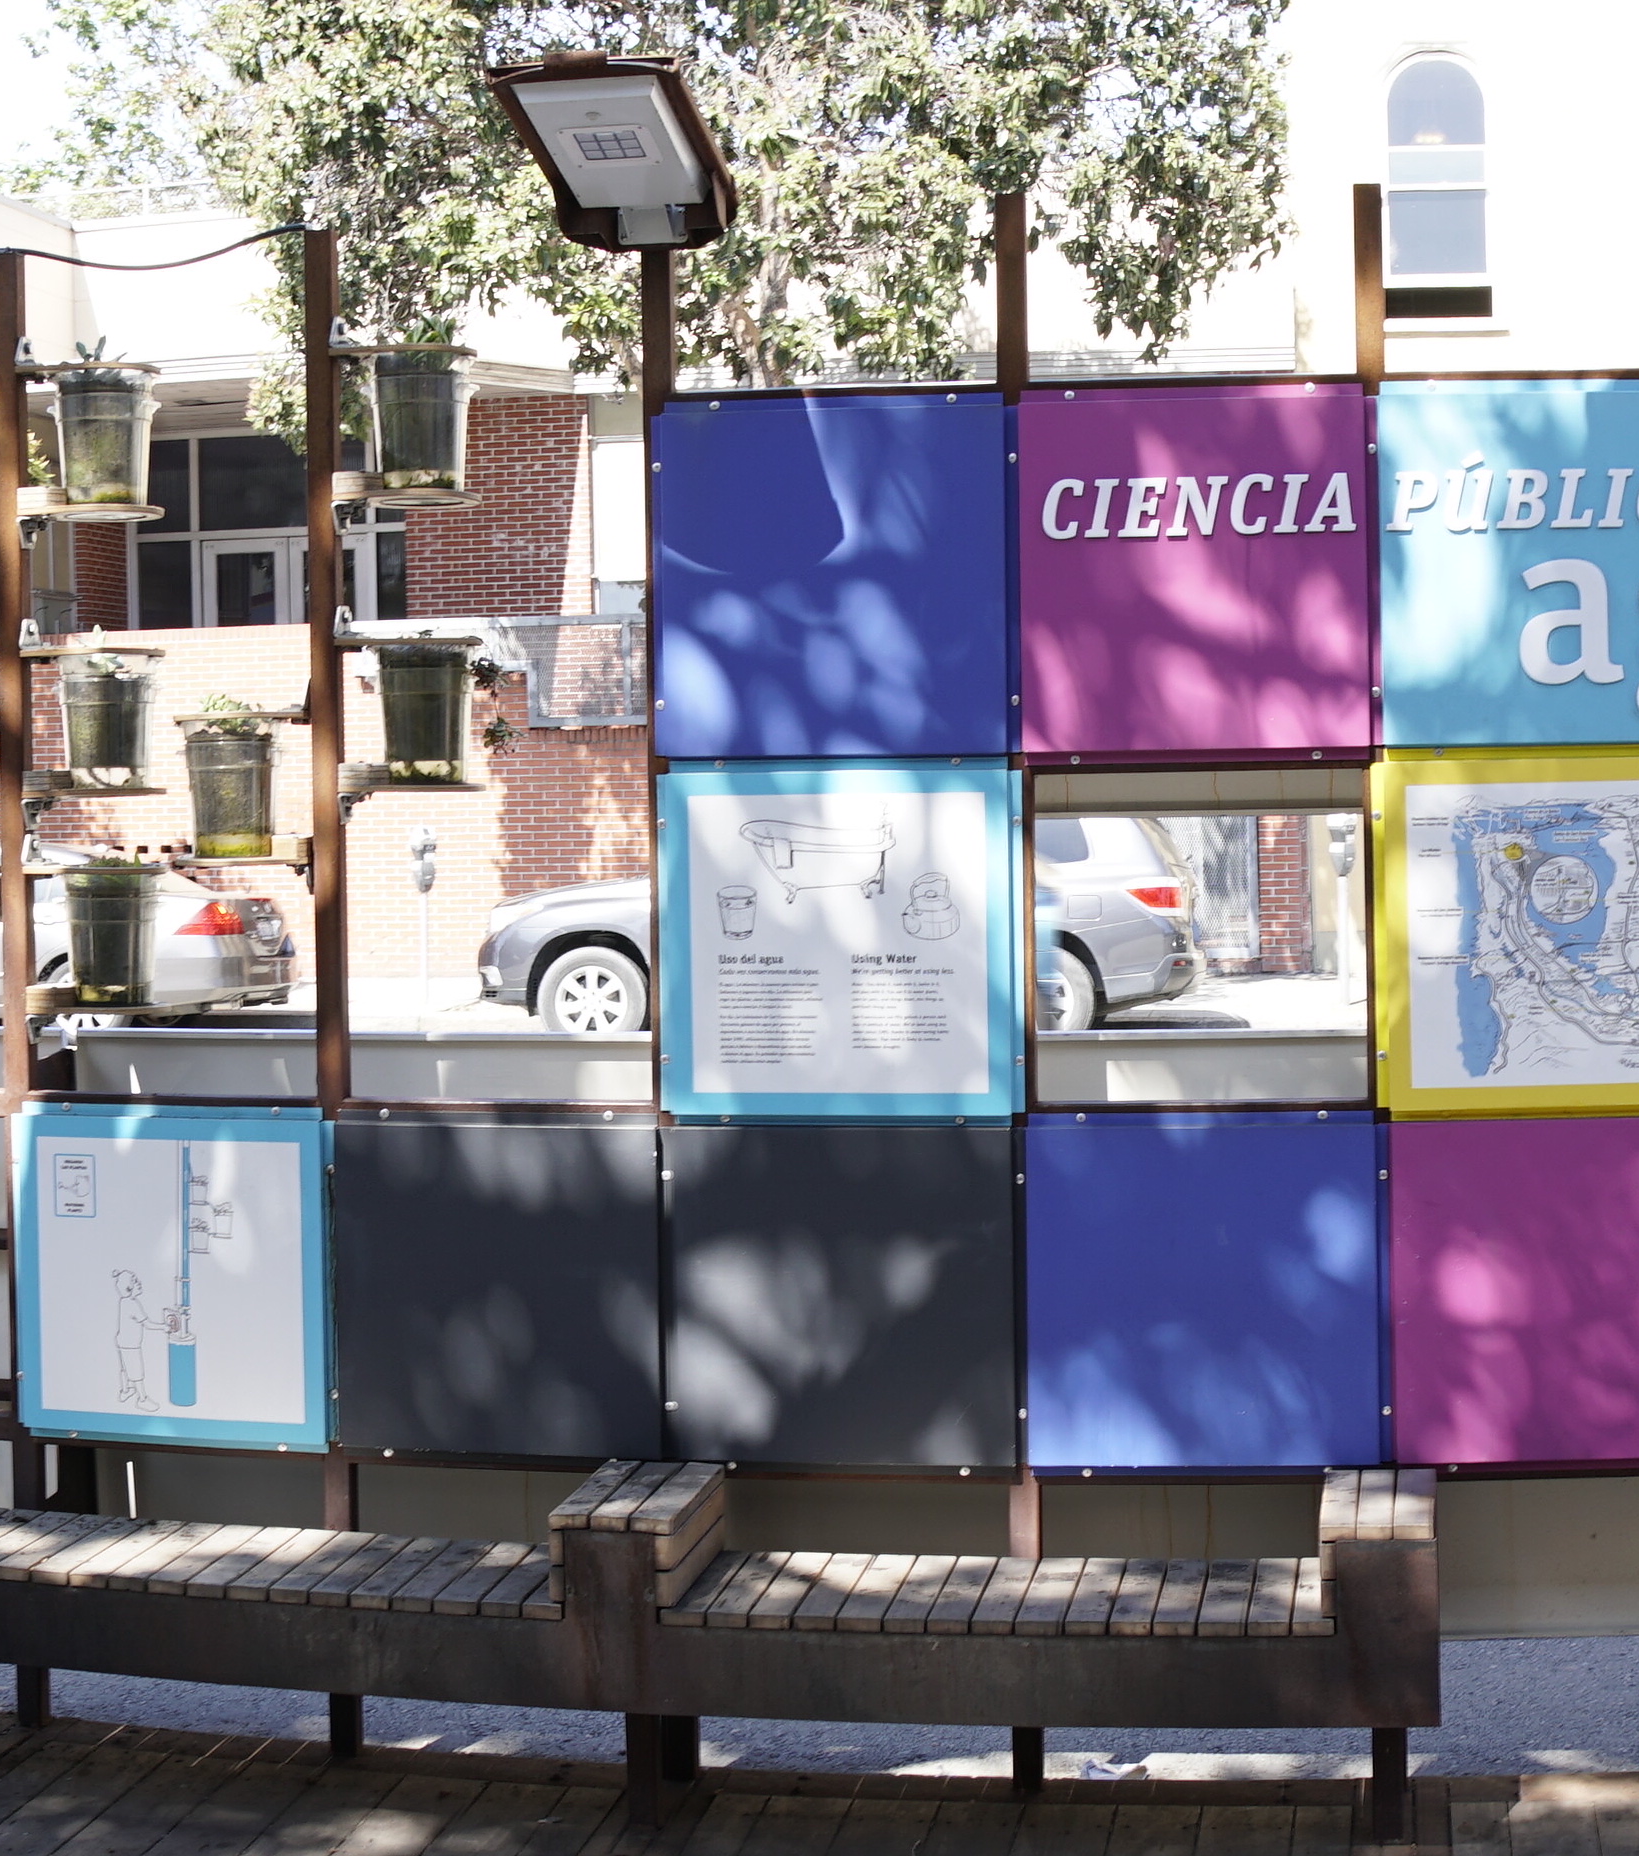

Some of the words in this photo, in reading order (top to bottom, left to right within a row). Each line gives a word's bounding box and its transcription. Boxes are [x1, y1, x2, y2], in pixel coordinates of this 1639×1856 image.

[1042, 471, 1357, 541] CIENCIA
[718, 954, 738, 964] Uso
[740, 954, 756, 964] del
[759, 955, 784, 966] agua
[851, 954, 882, 965] Using
[886, 954, 917, 963] Water
